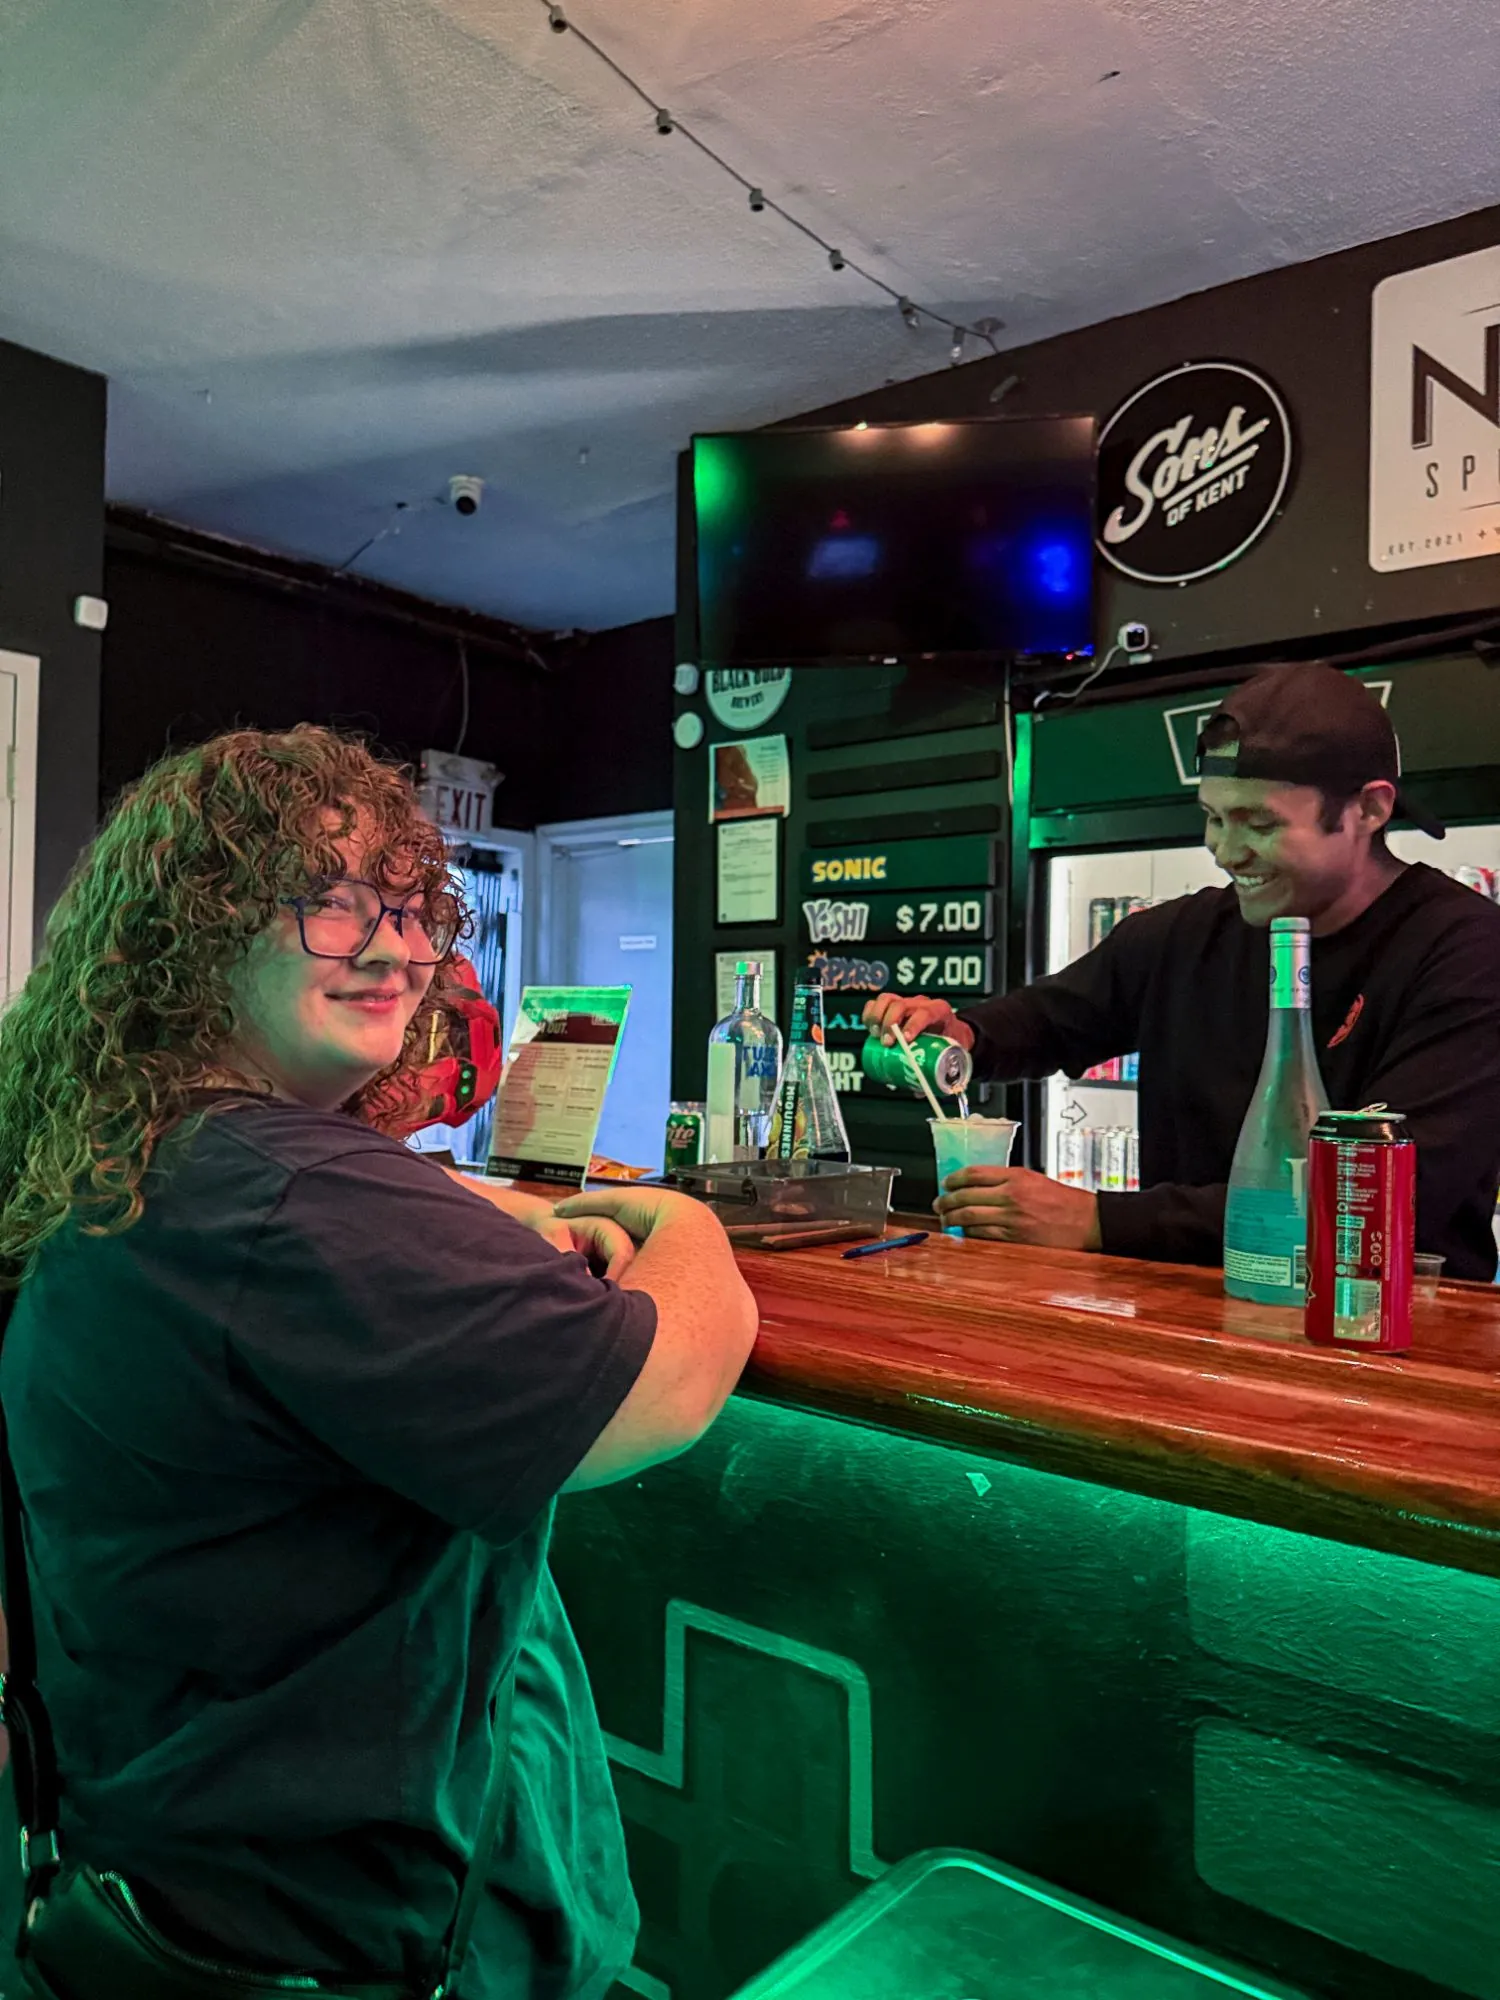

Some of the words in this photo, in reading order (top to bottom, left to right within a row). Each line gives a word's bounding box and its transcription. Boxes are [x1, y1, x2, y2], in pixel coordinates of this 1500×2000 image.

[1103, 406, 1270, 543] Sons
[1166, 499, 1193, 527] OF
[1196, 465, 1250, 512] KENT
[1426, 448, 1500, 499] SP
[435, 785, 487, 832] EXIT
[812, 856, 887, 883] SONIC
[802, 899, 869, 943] YOSHI
[825, 1052, 856, 1072] UD
